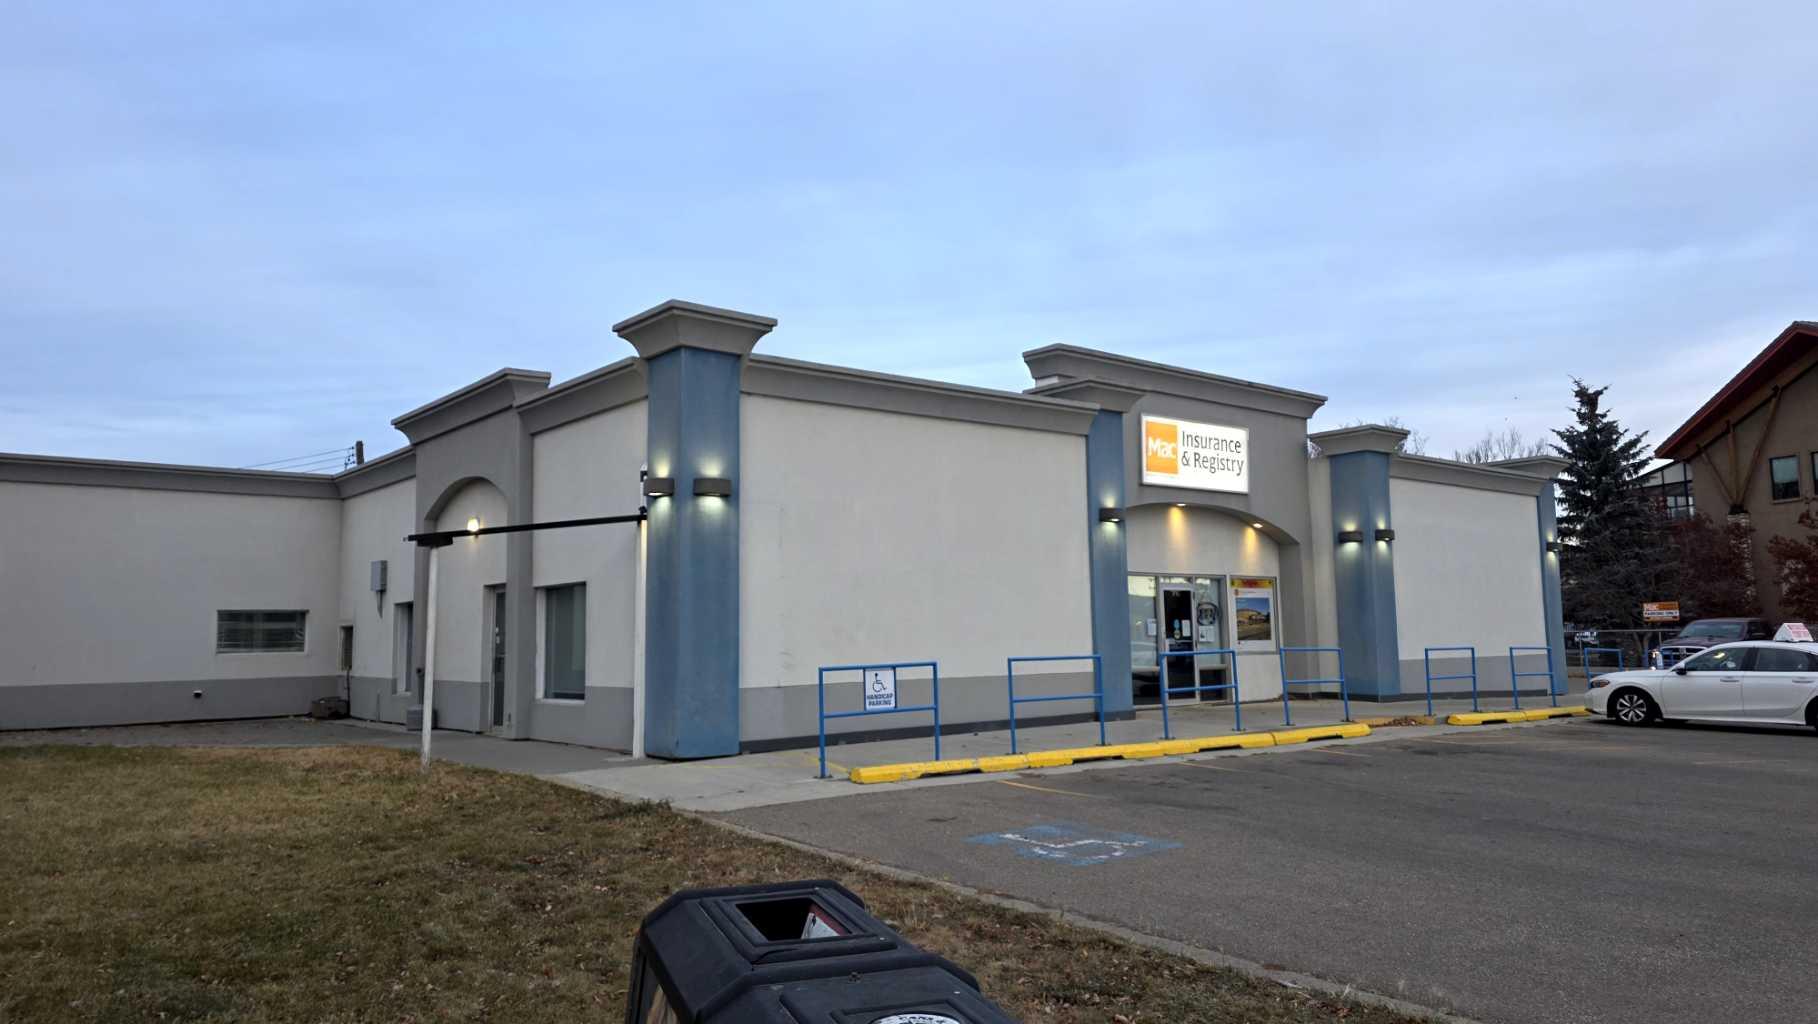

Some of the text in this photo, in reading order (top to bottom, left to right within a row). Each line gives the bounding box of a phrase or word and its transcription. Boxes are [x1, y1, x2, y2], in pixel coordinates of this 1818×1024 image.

[1147, 437, 1177, 459] Mac
[1181, 430, 1241, 453] Insurance
[1181, 451, 1244, 476] & Registry
